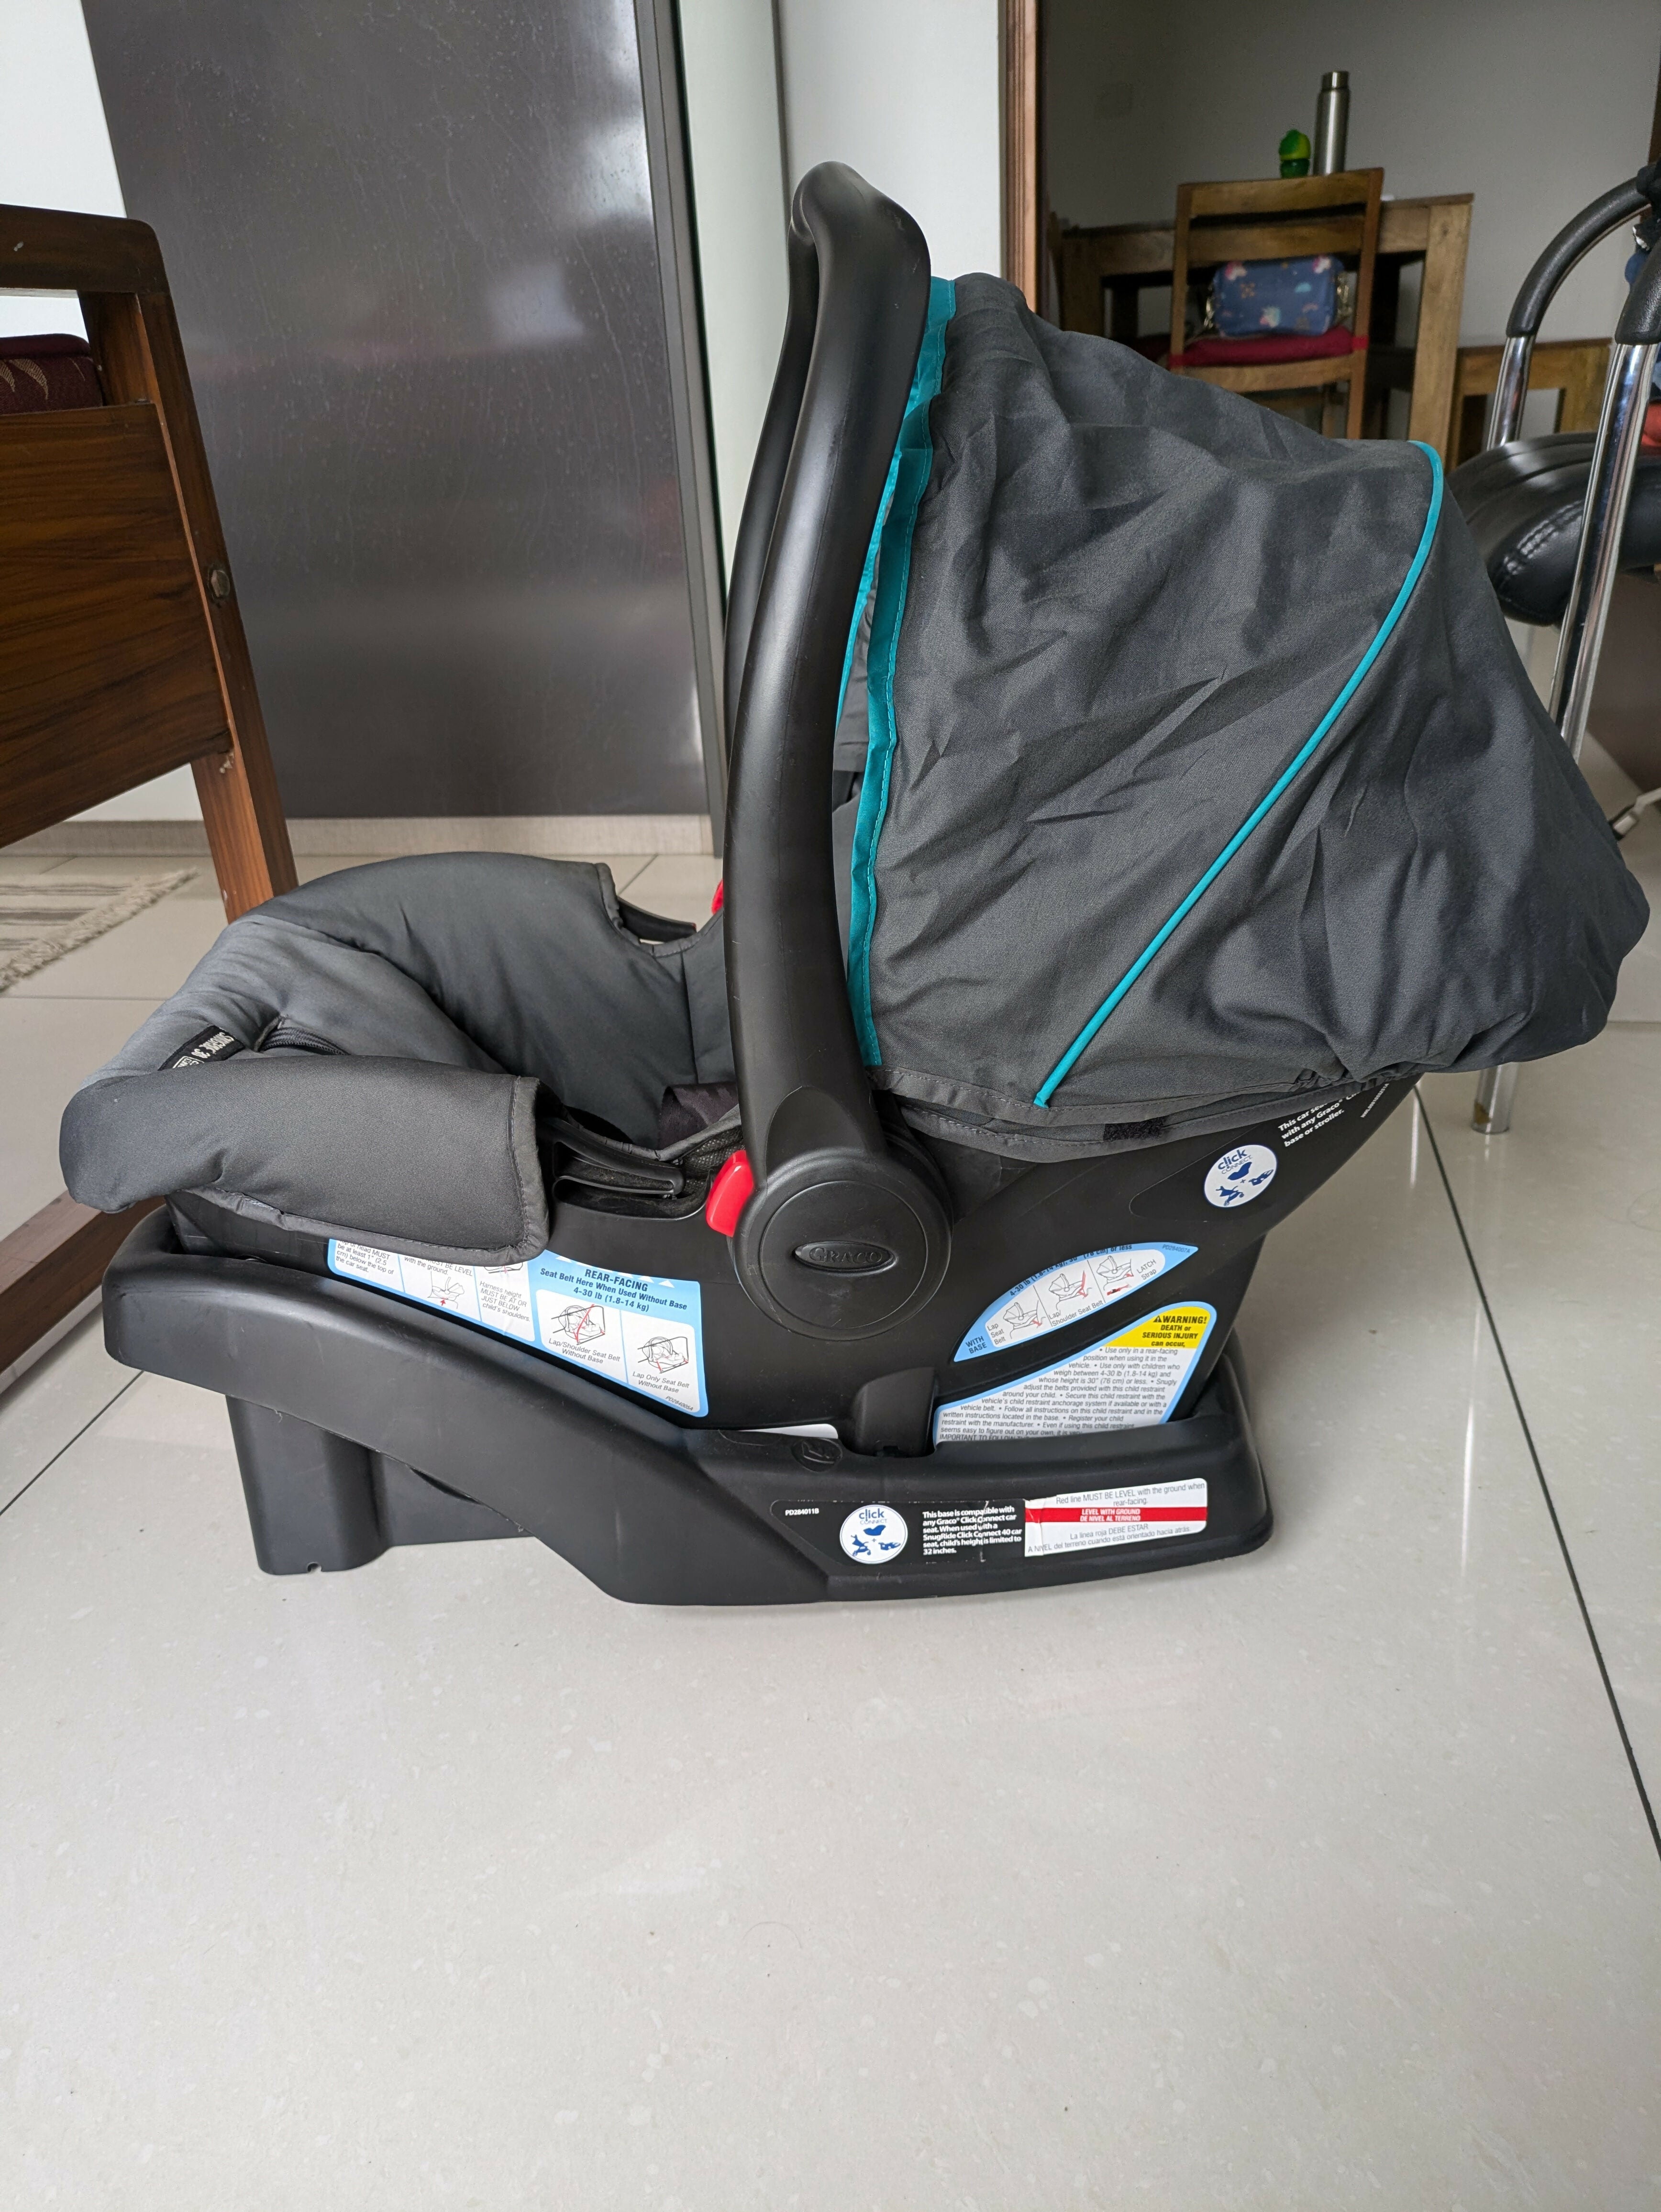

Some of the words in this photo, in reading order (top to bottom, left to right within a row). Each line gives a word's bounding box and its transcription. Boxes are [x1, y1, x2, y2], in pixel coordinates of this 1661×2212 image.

[1278, 1119, 1296, 1131] This
[1296, 1110, 1309, 1121] car
[1282, 1126, 1300, 1139] with
[1301, 1117, 1316, 1128] any
[1284, 1133, 1304, 1147] base
[1314, 1109, 1344, 1129] stroller.
[1221, 1155, 1252, 1174] CONNECT
[337, 1250, 348, 1259] cm)
[349, 1254, 366, 1265] below
[353, 1249, 365, 1258] least
[375, 1258, 387, 1266] (2.5
[372, 1250, 390, 1260] MUST
[356, 1263, 368, 1272] seat.
[427, 1265, 448, 1275] ground.
[454, 1265, 473, 1276] LEVEL
[1136, 1259, 1156, 1274] LATCH
[585, 1269, 648, 1292] REAR-FACING
[1141, 1269, 1157, 1281] Strap
[479, 1281, 503, 1293] Harness
[504, 1290, 521, 1298] height
[480, 1288, 498, 1297] MUST
[540, 1268, 557, 1278] Seat
[559, 1272, 574, 1282] Belt
[576, 1277, 593, 1288] Here
[596, 1283, 616, 1293] When
[619, 1288, 636, 1298] Used
[639, 1293, 668, 1305] Without
[670, 1300, 687, 1310] Base
[481, 1296, 498, 1304] JUST
[498, 1301, 520, 1311] BELOW
[574, 1287, 592, 1297] 4-30
[605, 1294, 634, 1307] (1.8-14
[637, 1302, 649, 1312] kg)
[482, 1303, 501, 1312] child's
[502, 1309, 530, 1321] shoulders.
[1049, 1311, 1061, 1320] Lap/
[1052, 1313, 1077, 1327] Shoulder
[1078, 1306, 1092, 1316] Seat
[1092, 1300, 1104, 1310] Belt
[1163, 1316, 1207, 1324] WARNING!
[987, 1323, 999, 1331] Lap
[991, 1329, 1005, 1338] Seat
[965, 1336, 984, 1349] WITH
[994, 1336, 1006, 1345] Belt
[549, 1338, 591, 1354] Lap/Shoulder
[592, 1349, 607, 1358] Seat
[969, 1343, 987, 1354] BASE
[562, 1348, 586, 1360] Without
[587, 1355, 603, 1363] Base
[632, 1371, 644, 1380] Lap
[646, 1374, 661, 1383] Only
[638, 1380, 662, 1390] Without
[1056, 1496, 1069, 1504] Red
[1070, 1495, 1081, 1503] line
[1083, 1493, 1102, 1502] MUST
[1115, 1490, 1136, 1498] LEVEL
[1163, 1484, 1186, 1494] ground
[785, 1508, 819, 1516] PD284011B
[923, 1533, 956, 1541] SnugRide
[974, 1529, 1001, 1537] Connect
[1108, 1526, 1126, 1534] DEBE
[1128, 1524, 1148, 1532] ESTAR
[961, 1538, 983, 1546] height
[1034, 1543, 1052, 1551] NIVEL
[1064, 1539, 1086, 1548] terreno
[1088, 1537, 1110, 1546] cuando
[1127, 1531, 1155, 1540] orientado
